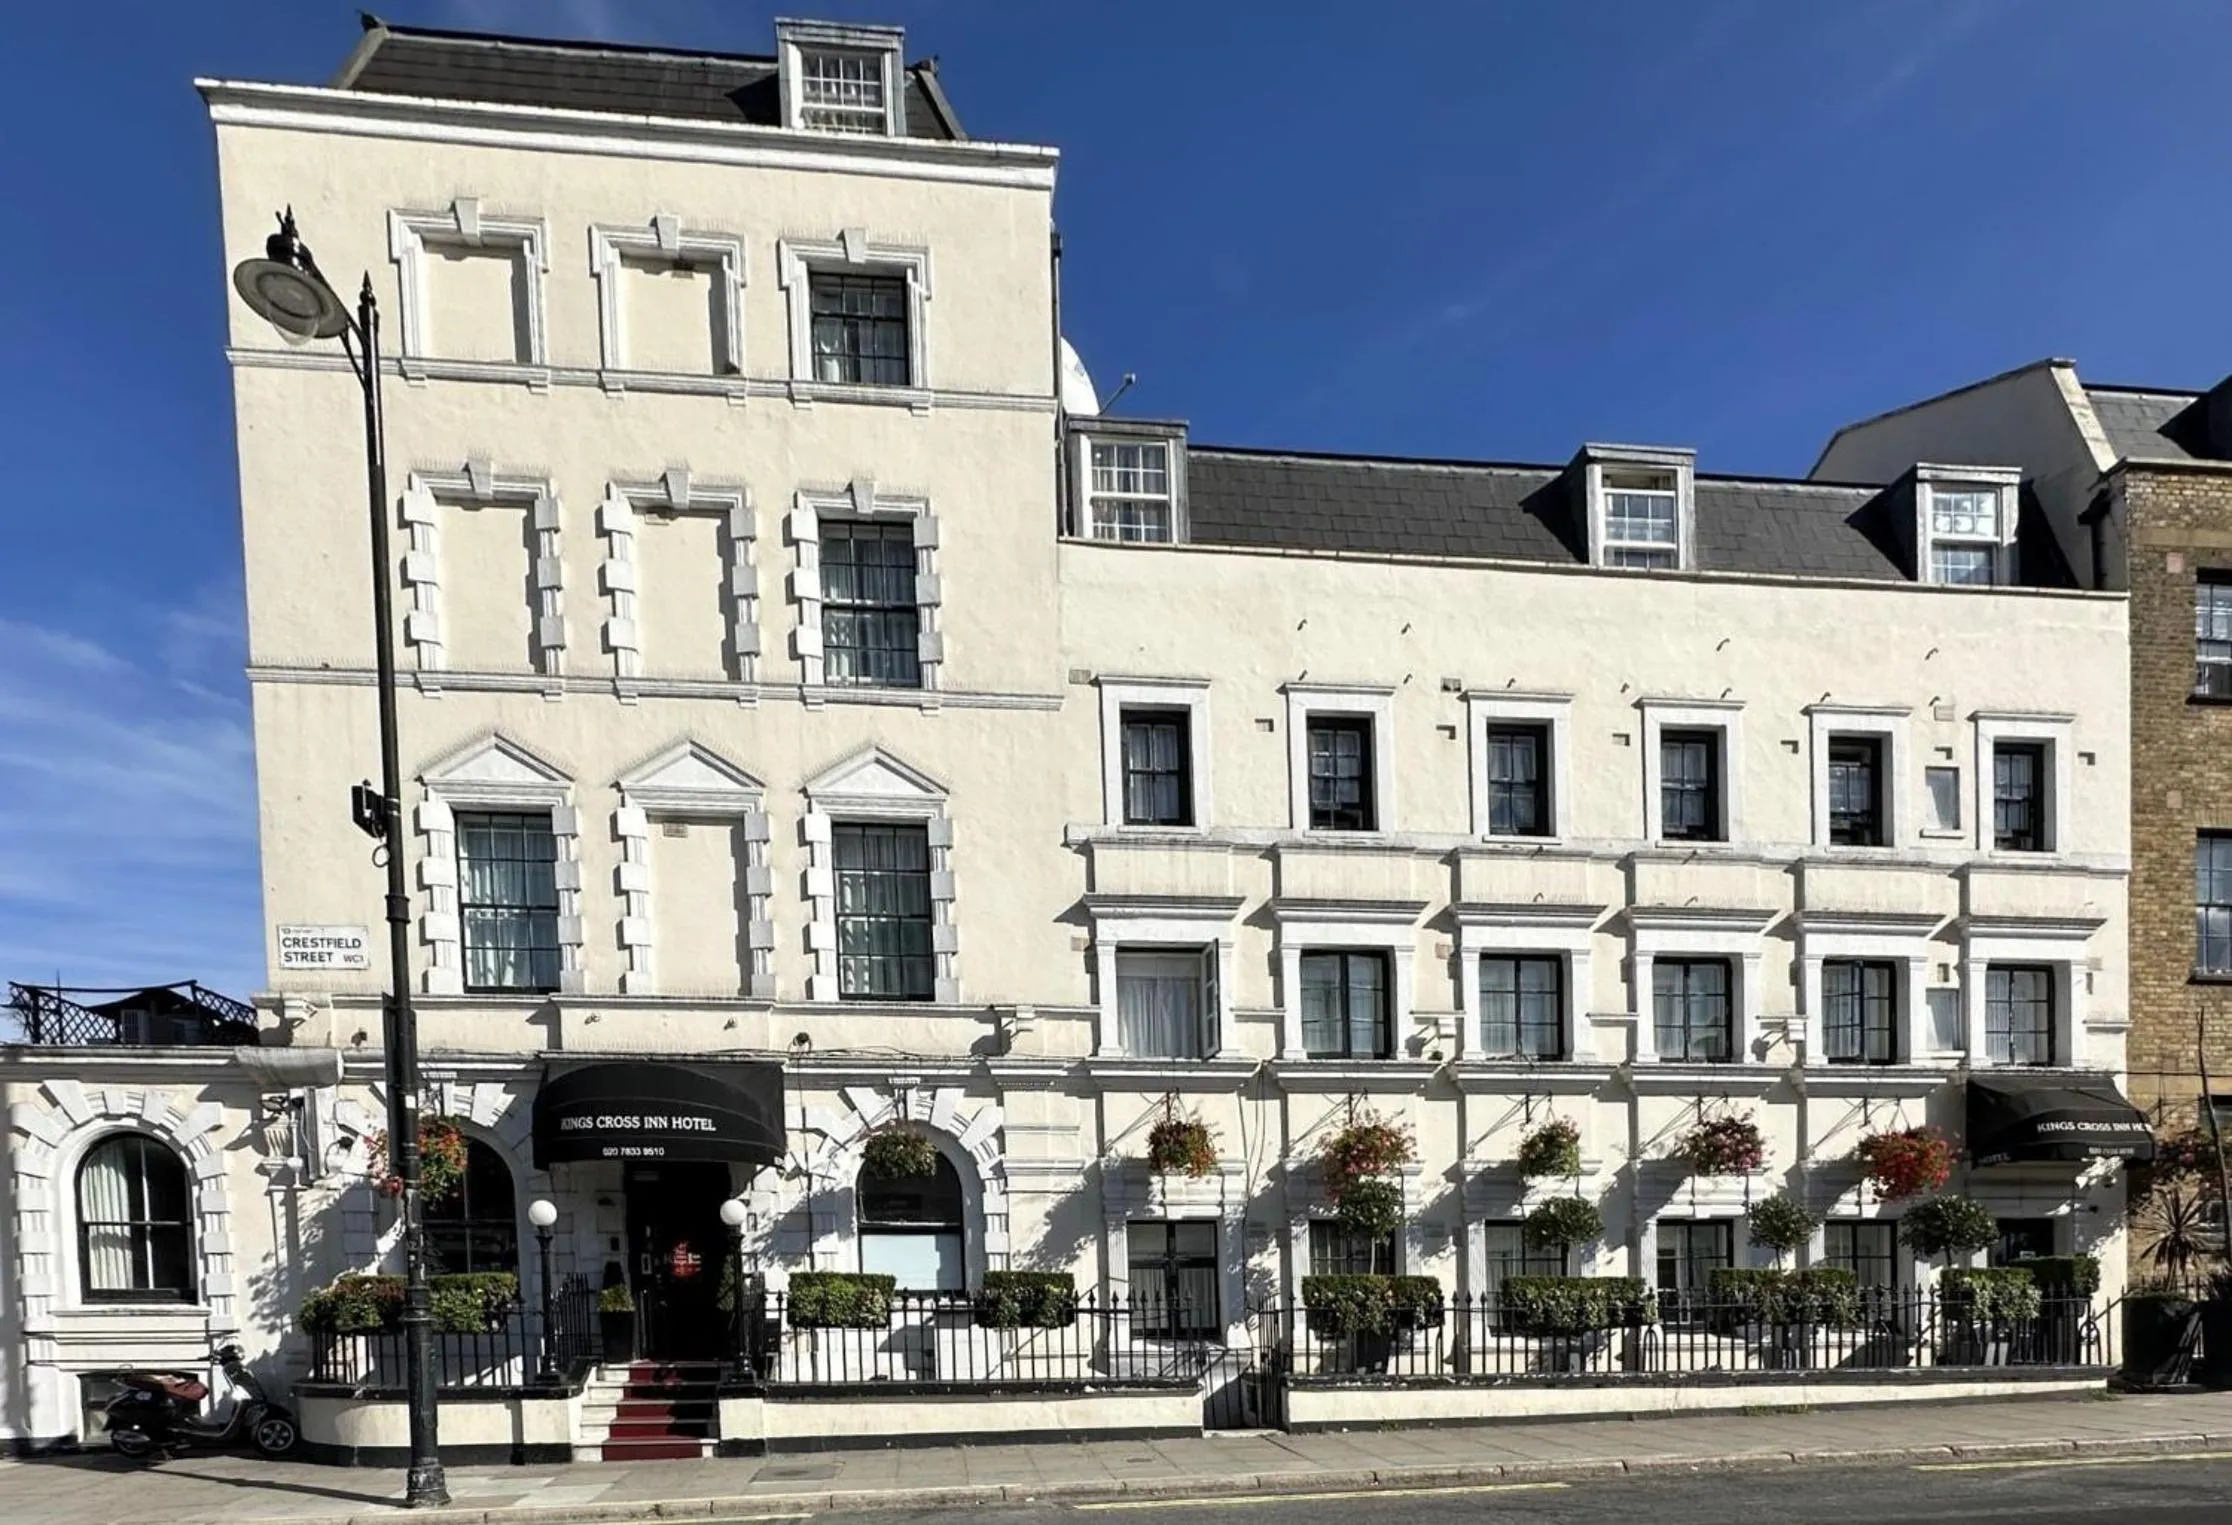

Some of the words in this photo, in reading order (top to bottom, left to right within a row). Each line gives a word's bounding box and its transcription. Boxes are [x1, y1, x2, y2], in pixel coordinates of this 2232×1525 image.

[281, 937, 362, 949] CRESTFIELD
[283, 951, 334, 962] STREET
[560, 1117, 593, 1130] KINGS
[596, 1116, 640, 1129] CROSS
[644, 1116, 668, 1129] INN
[672, 1116, 717, 1131] HOTEL
[2036, 1121, 2076, 1133] KINGS
[2077, 1121, 2112, 1132] CROSS
[2113, 1122, 2131, 1132] INN
